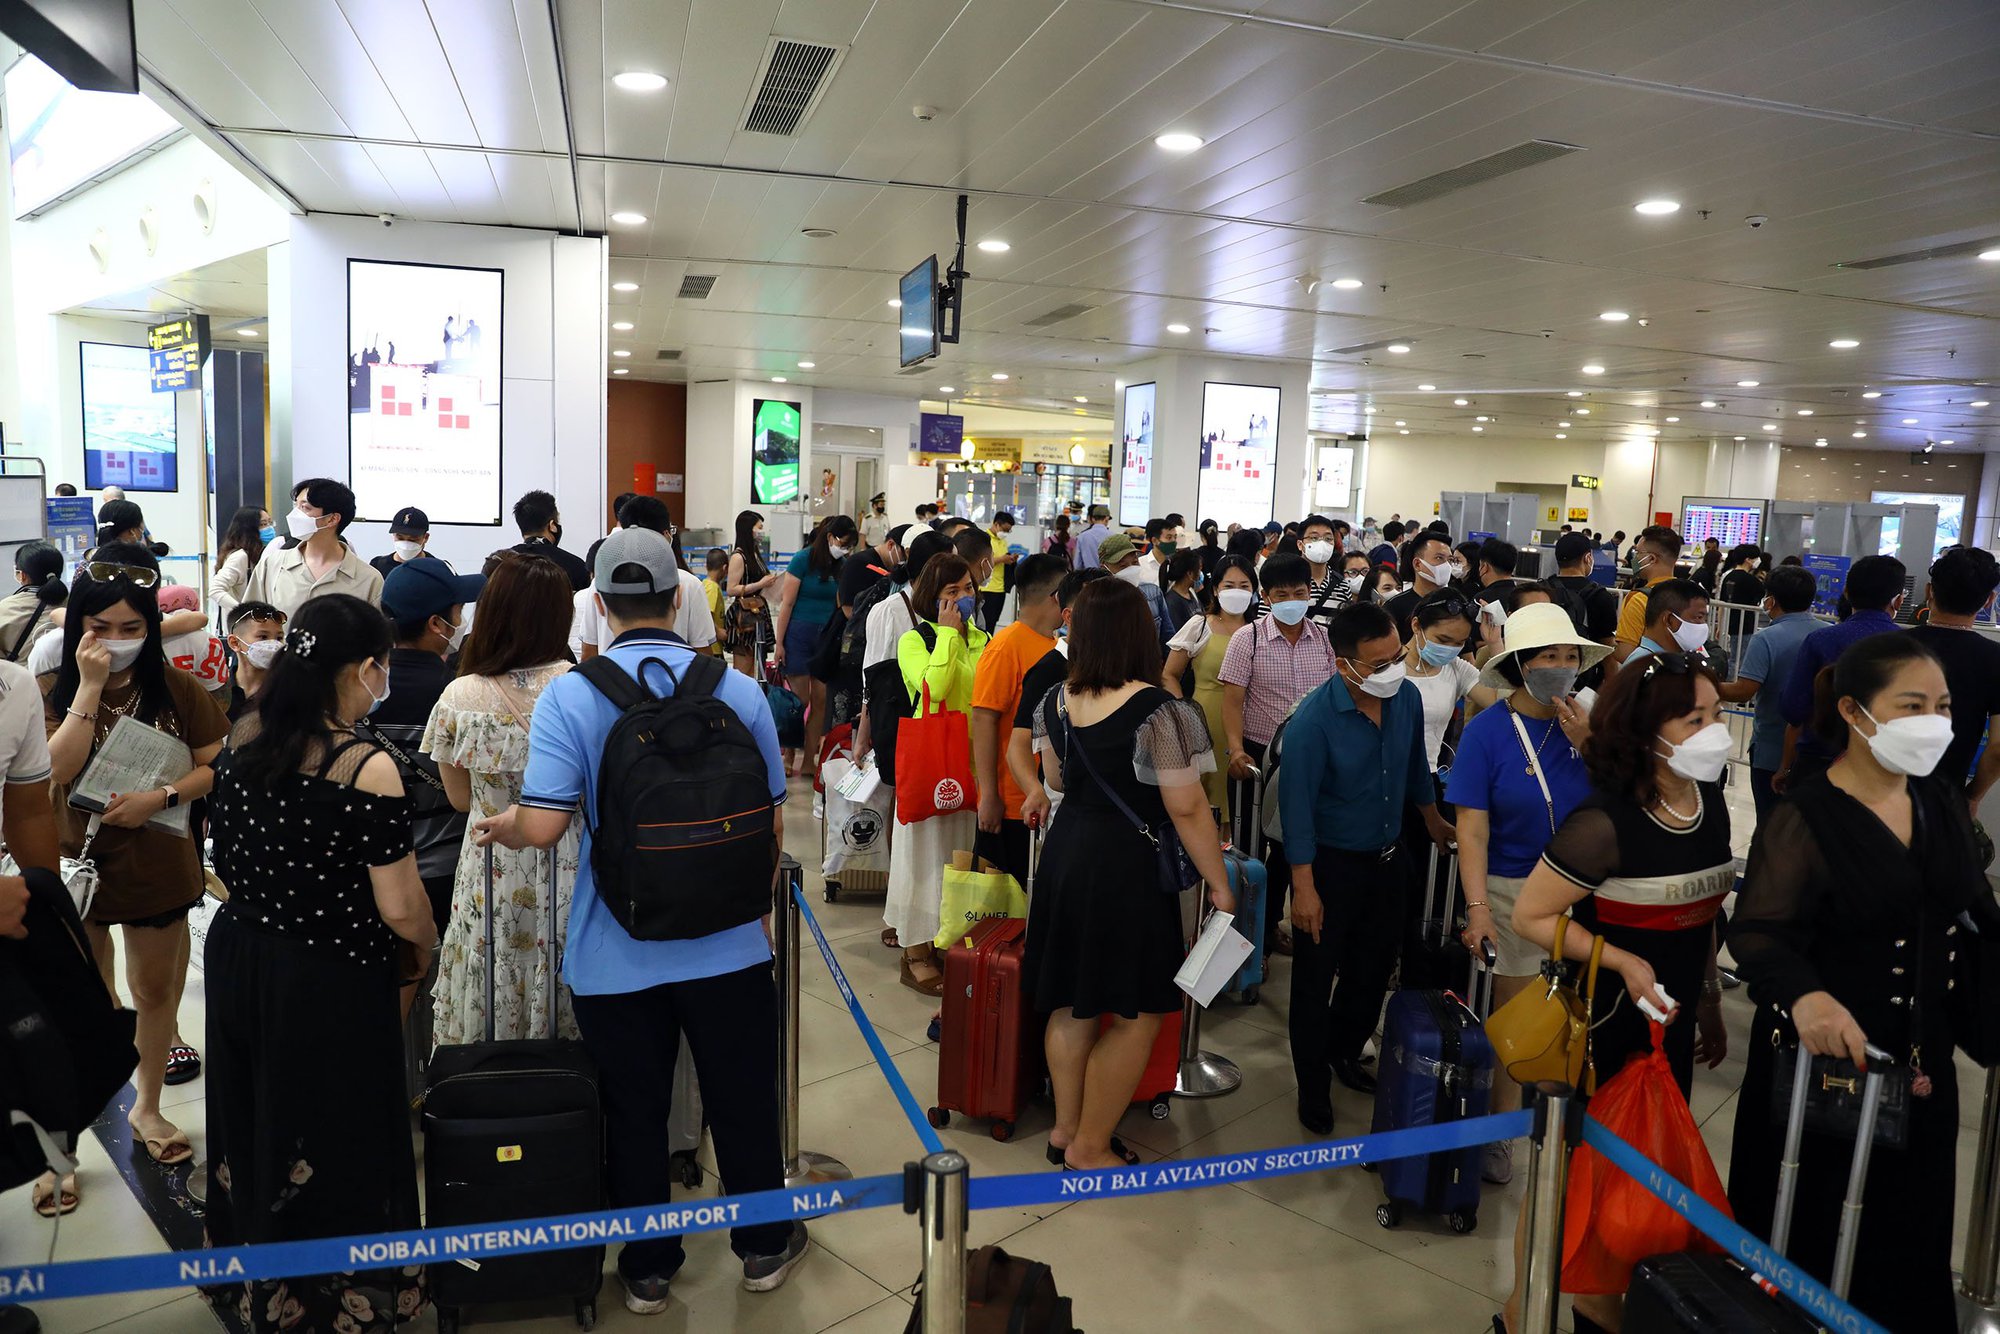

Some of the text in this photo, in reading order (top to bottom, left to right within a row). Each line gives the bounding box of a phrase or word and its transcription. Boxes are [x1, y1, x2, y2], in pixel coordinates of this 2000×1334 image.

[374, 730, 411, 765] adidas
[1060, 1143, 1364, 1195] NOI BAI AVIATION SECURITY
[180, 1256, 245, 1280] N.I.A
[349, 1237, 436, 1264] NOIBAI
[445, 1217, 635, 1254] INTERNATIONAL
[643, 1203, 740, 1232] AIRPORT
[793, 1189, 844, 1213] N.I.A
